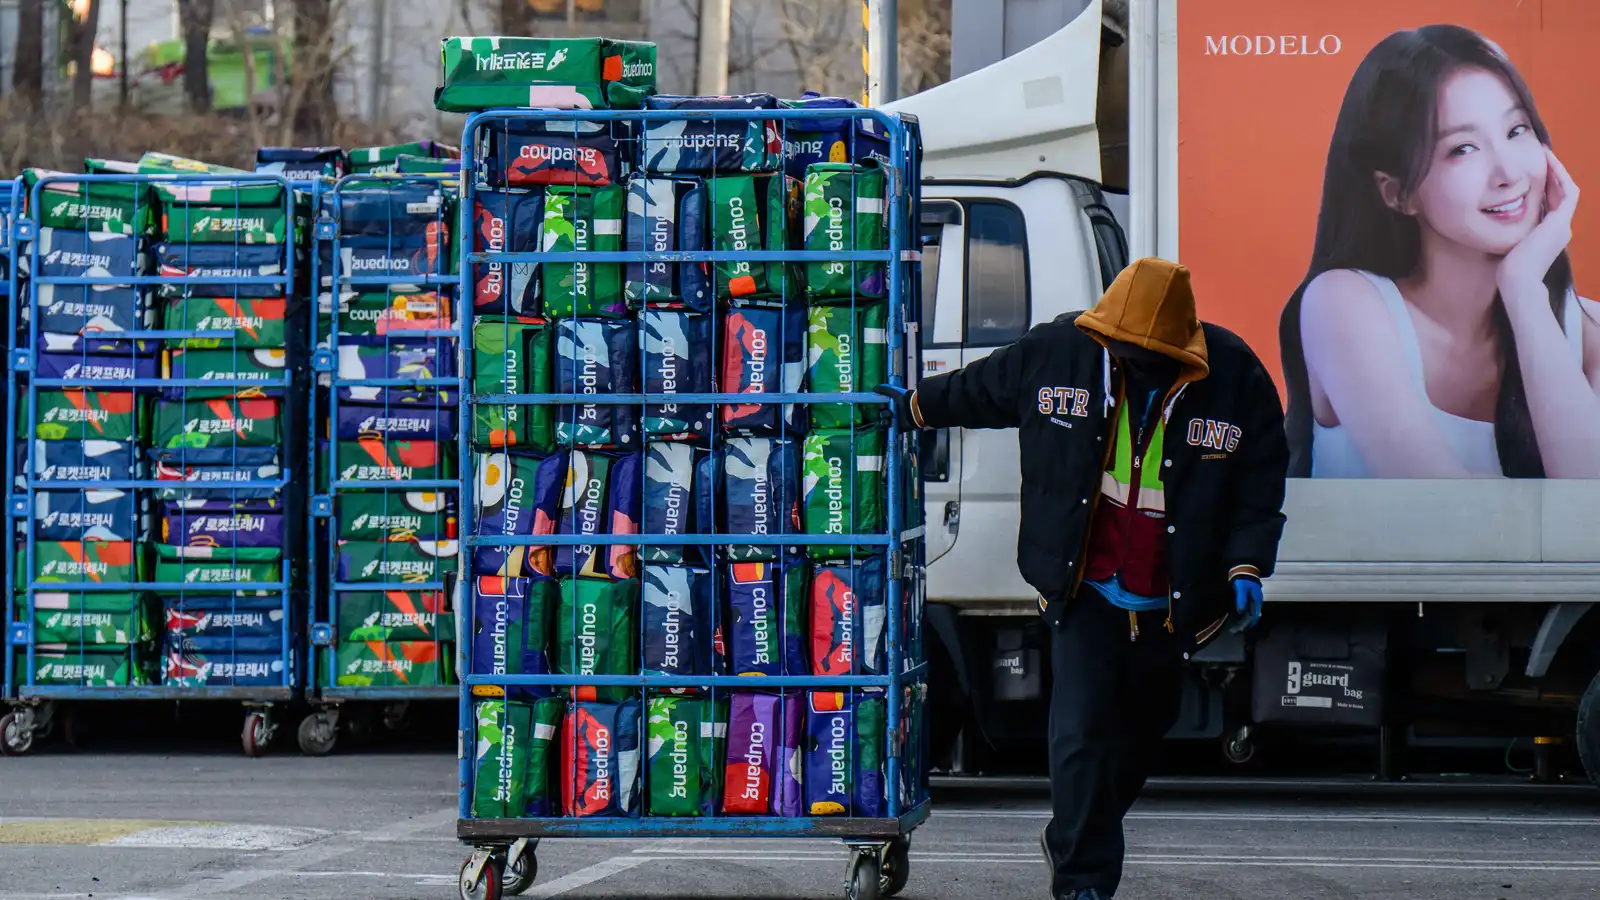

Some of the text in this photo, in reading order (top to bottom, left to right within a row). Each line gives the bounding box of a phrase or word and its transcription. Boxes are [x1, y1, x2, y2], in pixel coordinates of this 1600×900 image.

[1204, 34, 1342, 56] MODELO
[476, 51, 547, 71] 로켓프레시
[622, 58, 653, 77] coupang
[663, 132, 740, 151] coupang
[519, 144, 597, 167] coupang
[67, 203, 122, 220] 로켓프레시
[728, 197, 750, 275] coupag
[825, 197, 844, 275] coupag
[59, 252, 110, 268] 로켓프레시
[351, 255, 409, 271] coupang
[569, 219, 587, 296] couang
[62, 302, 114, 318] 로켓프레시
[350, 309, 408, 323] coupang
[211, 315, 263, 330] 로켓프레시
[80, 365, 135, 380] 로켓프레시
[659, 337, 677, 413] coupag
[747, 328, 766, 406] coupan
[834, 334, 852, 405] coupan
[1037, 386, 1090, 417] STR
[58, 407, 109, 423] 로켓프레시
[198, 417, 253, 432] 로켓프레시
[375, 417, 431, 432] 로켓프레시
[1187, 417, 1242, 452] ONG
[55, 465, 111, 481] 로켓프레시
[357, 465, 413, 481] 로켓프레시
[824, 457, 842, 535] coupang
[58, 513, 113, 528] 로켓프레시
[204, 516, 265, 532] 로켓프레시
[367, 515, 421, 530] 로켓프레시
[575, 478, 601, 556] coupag
[56, 561, 107, 576] 로켓프레시
[200, 567, 251, 582] 로켓프레시
[378, 561, 434, 576] 로켓프레시
[60, 612, 111, 627] 로켓프레시
[212, 612, 263, 627] 로켓프레시
[381, 612, 436, 627] 로켓프레시
[750, 587, 770, 665] coupang
[837, 591, 856, 663] coupang
[661, 590, 680, 668] coupang
[51, 663, 105, 679] 로켓프레시
[212, 662, 269, 678] 로켓프레시
[362, 659, 412, 673] 로켓프레시
[1302, 671, 1349, 687] guard
[1344, 686, 1363, 700] bag
[493, 724, 515, 803] coupang
[668, 720, 688, 798] coupang
[741, 722, 765, 800] coupang
[827, 717, 845, 795] coupang
[592, 728, 608, 801] coupang
